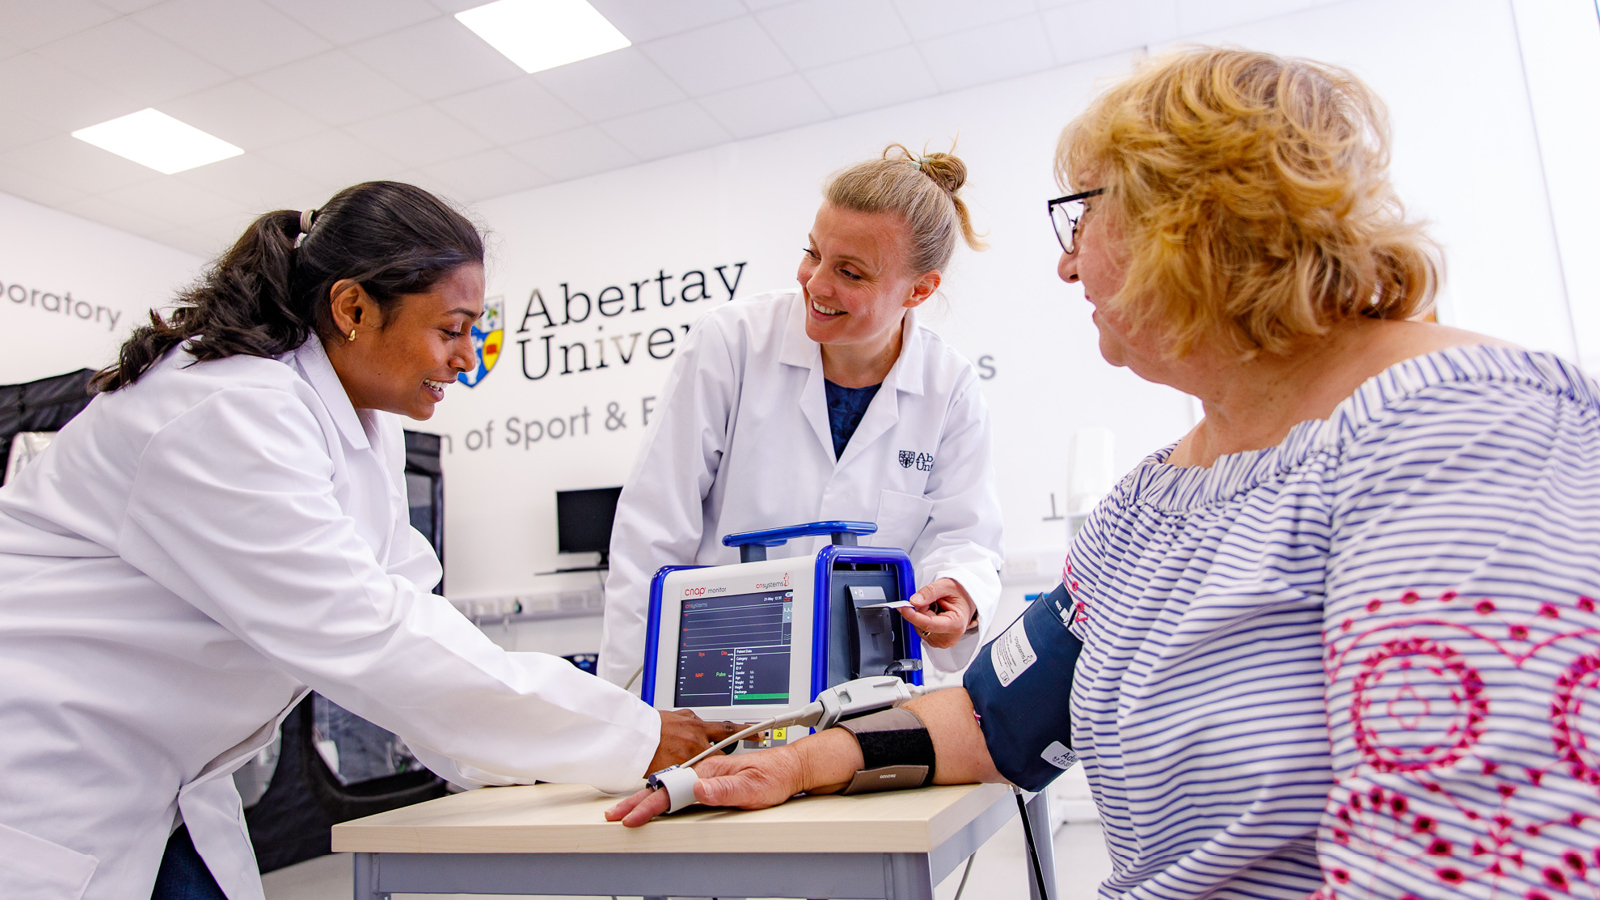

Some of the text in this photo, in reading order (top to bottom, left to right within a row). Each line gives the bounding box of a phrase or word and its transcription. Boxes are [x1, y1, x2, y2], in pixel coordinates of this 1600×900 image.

[0, 281, 122, 332] oratory
[516, 261, 748, 334] Abertay
[465, 419, 494, 451] of
[505, 405, 592, 451] Sport
[604, 401, 627, 431] &
